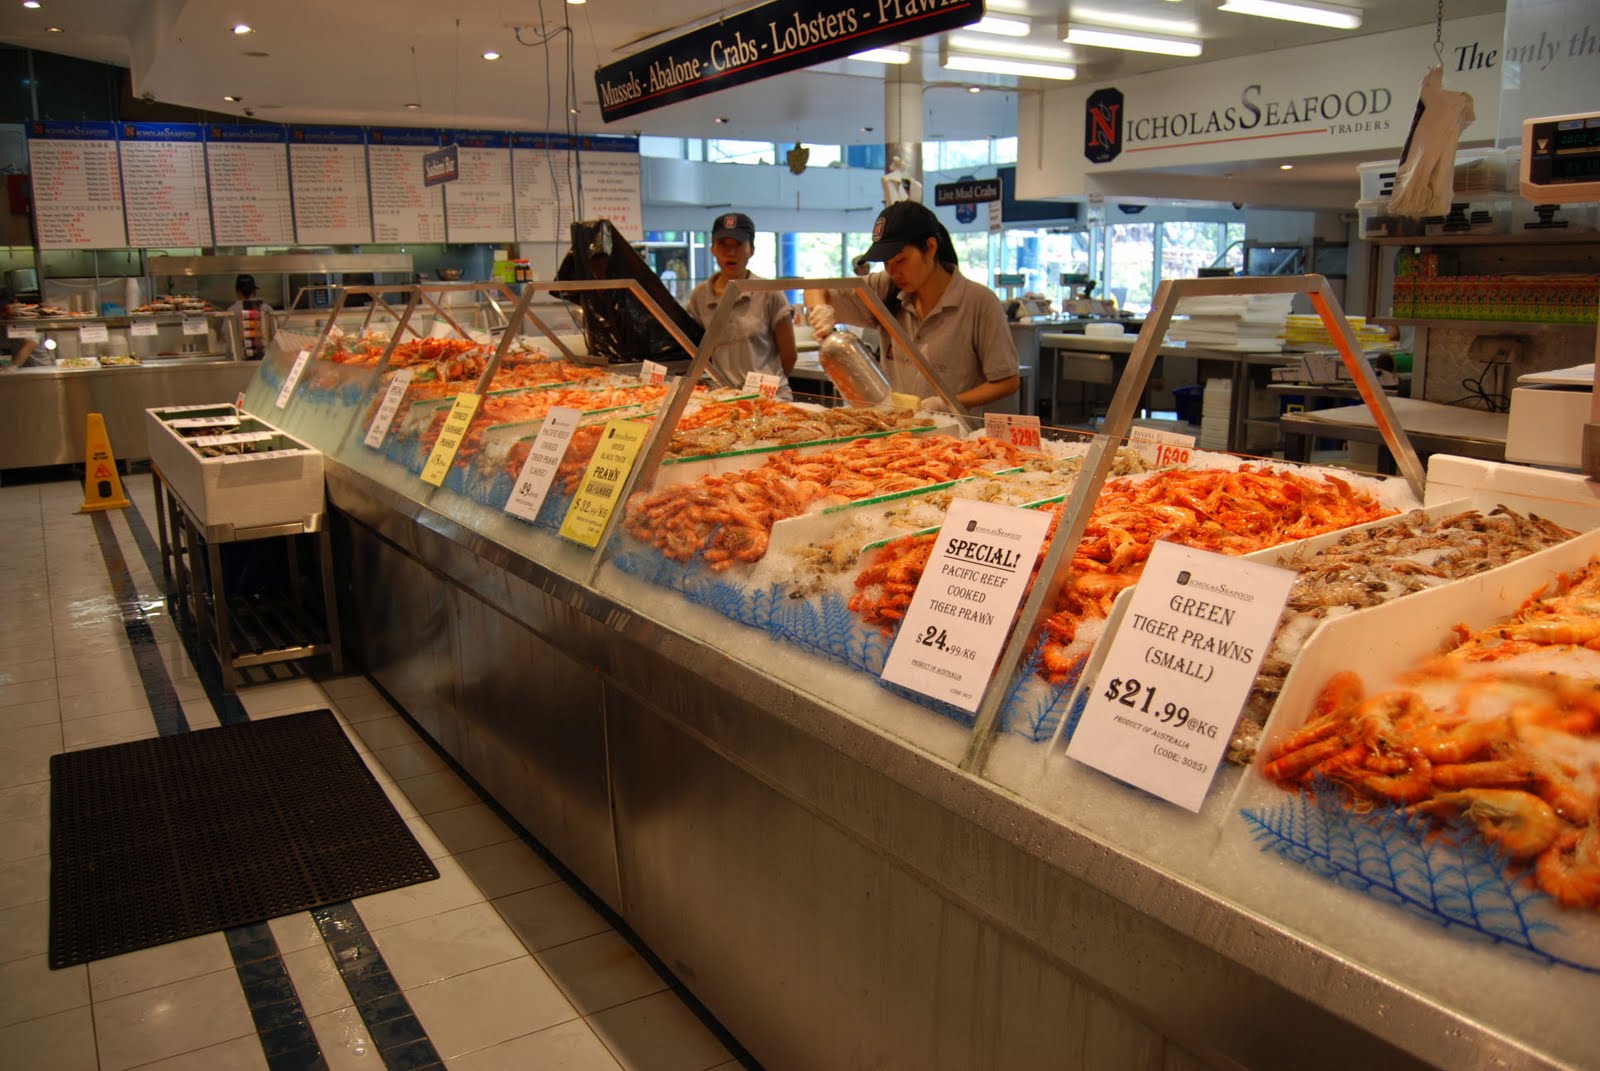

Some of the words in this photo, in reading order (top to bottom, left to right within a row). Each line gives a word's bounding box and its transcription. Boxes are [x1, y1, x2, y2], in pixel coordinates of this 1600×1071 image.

[601, 71, 641, 107] Mussels
[650, 56, 700, 92] Abalone
[710, 31, 759, 71] Crabs
[769, 7, 858, 54] Lobsters
[1454, 42, 1497, 72] The
[1505, 32, 1560, 71] only
[1568, 25, 1600, 58] th
[1329, 119, 1390, 135] TRADERS
[974, 184, 997, 198] Crabs
[593, 466, 620, 482] PRAWN
[945, 538, 1021, 569] SPECIAL!
[941, 564, 979, 582] PACIFIC
[980, 572, 1008, 588] REEF
[947, 584, 986, 603] COOKED
[929, 599, 959, 617] TIGER
[957, 606, 995, 626] PRAWN
[1169, 595, 1236, 626] GREEN
[1131, 613, 1179, 642] TIGER
[1181, 630, 1254, 664] PRAWNS
[1144, 646, 1214, 682] (SMALL)
[1113, 715, 1143, 730] PRODUCT
[1151, 730, 1190, 749] AUSTRALIA
